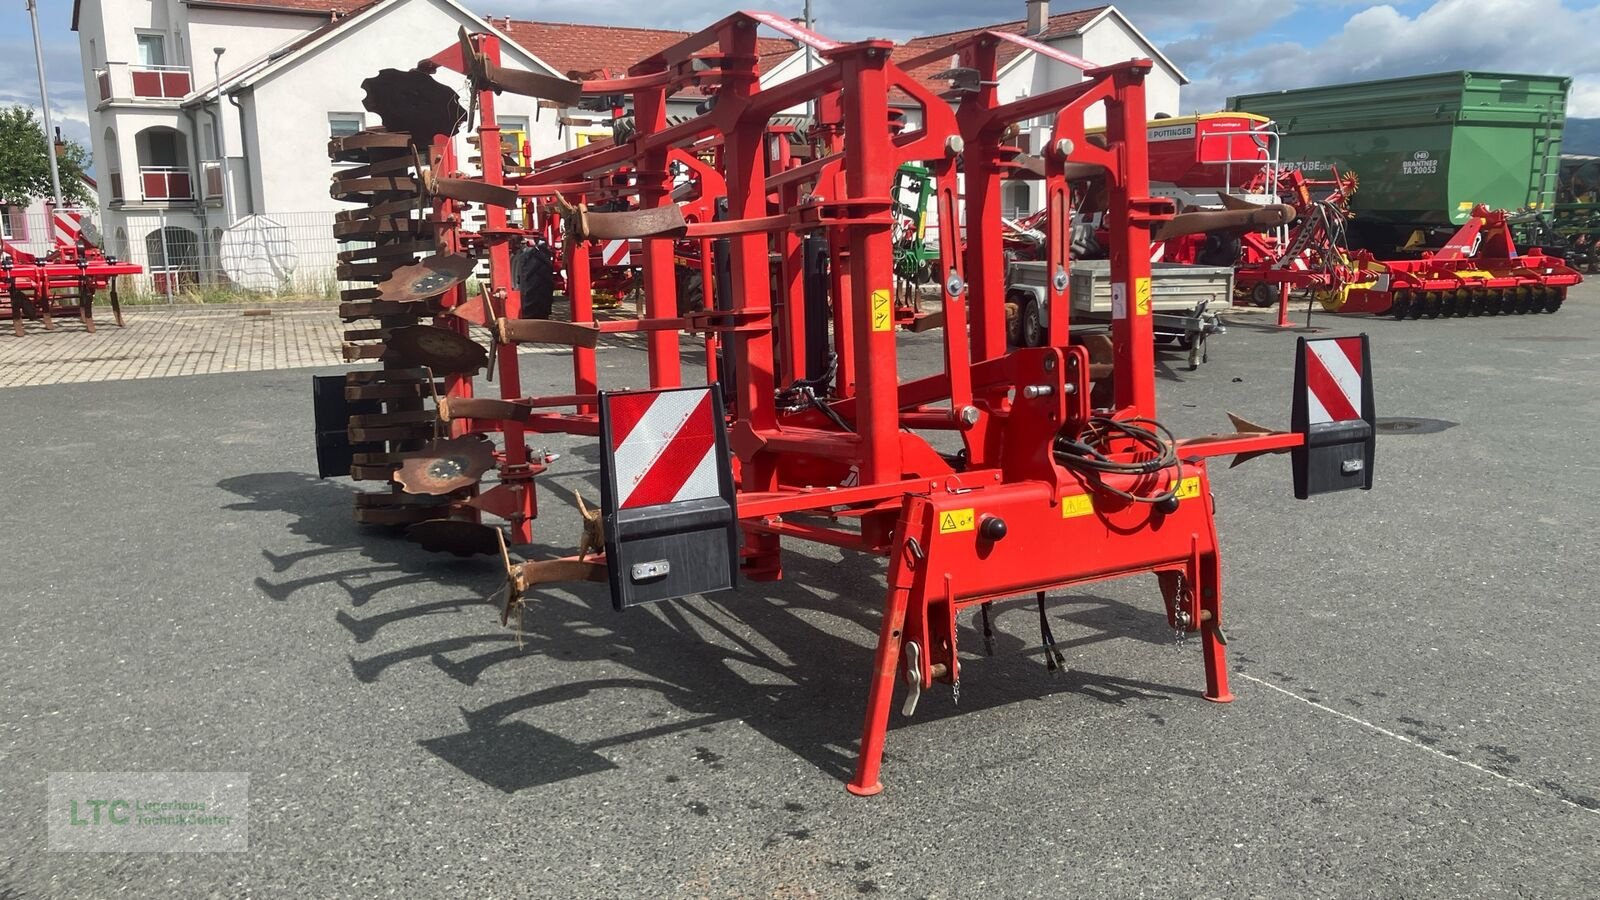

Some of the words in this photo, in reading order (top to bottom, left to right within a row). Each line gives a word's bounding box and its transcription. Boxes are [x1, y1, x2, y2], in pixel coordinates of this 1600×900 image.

[1403, 160, 1438, 168] BRANTNER
[1403, 167, 1413, 175] TA
[1414, 166, 1437, 175] 20053
